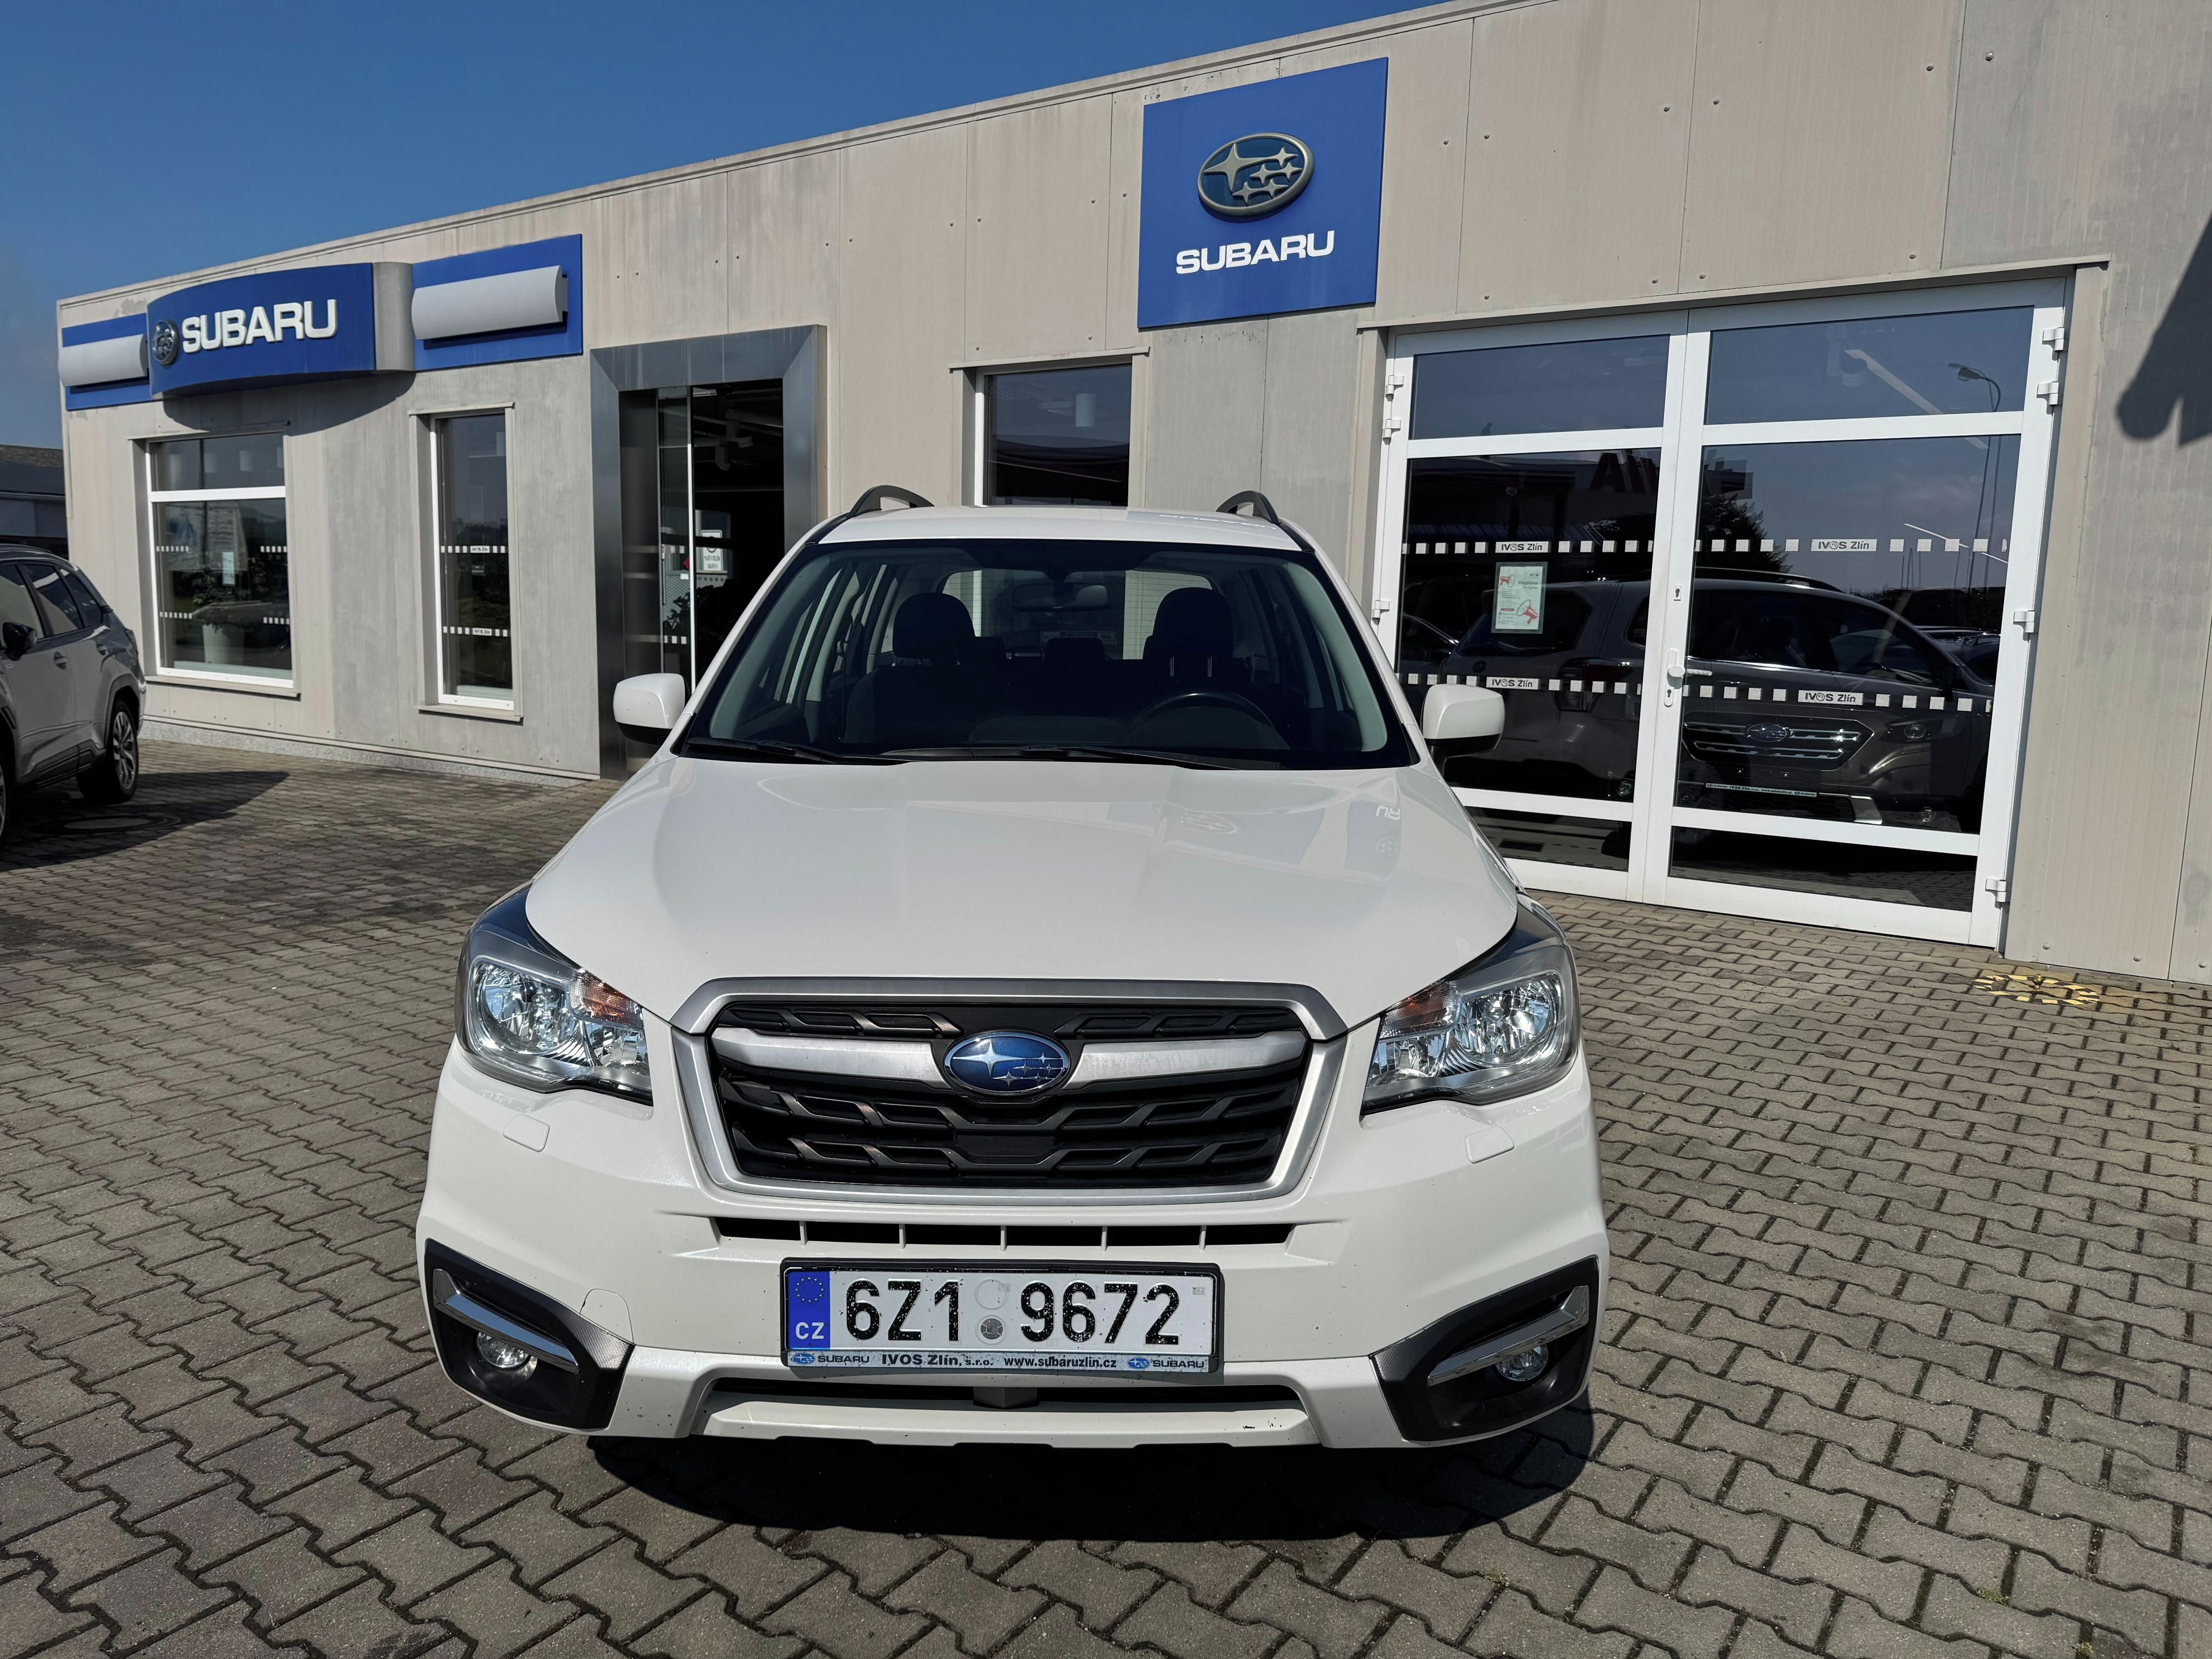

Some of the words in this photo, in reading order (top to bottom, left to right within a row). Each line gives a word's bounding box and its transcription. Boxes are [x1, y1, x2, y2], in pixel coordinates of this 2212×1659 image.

[1176, 231, 1334, 274] SUBARU
[182, 299, 336, 353] SUBARU
[1851, 541, 1869, 549] Zlín
[1837, 694, 1856, 702] Zlín
[846, 1278, 960, 1341] 6Z1
[1021, 1281, 1179, 1345] 9672
[795, 1321, 825, 1340] CZ
[818, 1355, 870, 1364] SUBARU
[881, 1354, 923, 1365] IVOS
[1004, 1356, 1117, 1368] www.subaruzlin.cz
[1152, 1359, 1205, 1368] SUBARU
